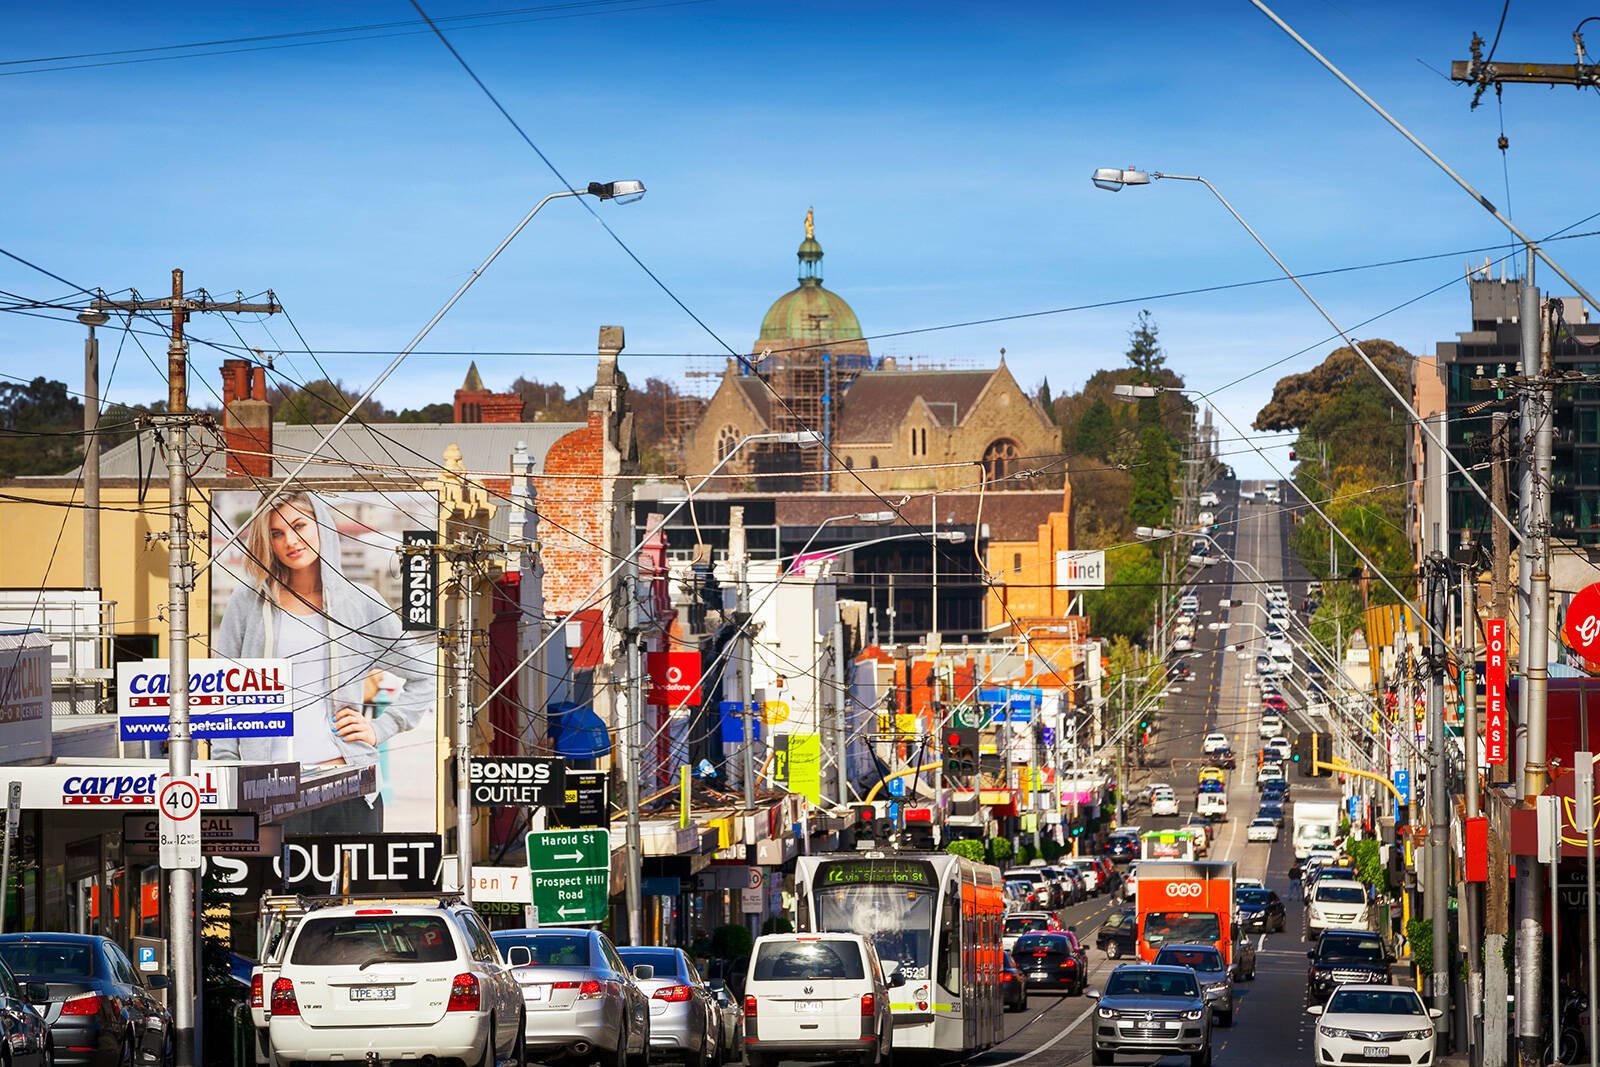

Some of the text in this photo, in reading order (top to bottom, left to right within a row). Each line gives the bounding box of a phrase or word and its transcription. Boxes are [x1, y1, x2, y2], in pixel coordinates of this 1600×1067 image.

[1069, 561, 1100, 578] iinet
[1492, 625, 1501, 666] FOR
[129, 668, 284, 694] capetCALL
[657, 683, 691, 692] vodafone
[131, 695, 284, 706] FLOR CENTRE
[126, 718, 285, 735] www.petcall.com.au
[1491, 686, 1501, 756] LEASE
[470, 763, 550, 781] BONDS
[63, 773, 217, 799] carpetL
[65, 796, 154, 804] FLOOR
[166, 792, 193, 808] 40
[475, 786, 541, 802] OUTLET
[145, 819, 232, 831] caCALL
[541, 834, 595, 846] Harold St
[273, 842, 434, 882] OUTLET
[511, 876, 518, 890] 7
[536, 875, 604, 888] Prospect Hill
[845, 873, 859, 881] via
[912, 872, 923, 881] St
[559, 889, 583, 900] Road
[1168, 884, 1200, 896] TNT
[473, 903, 520, 912] BONDS
[425, 932, 436, 945] P
[143, 949, 152, 961] P
[899, 967, 926, 978] 3523
